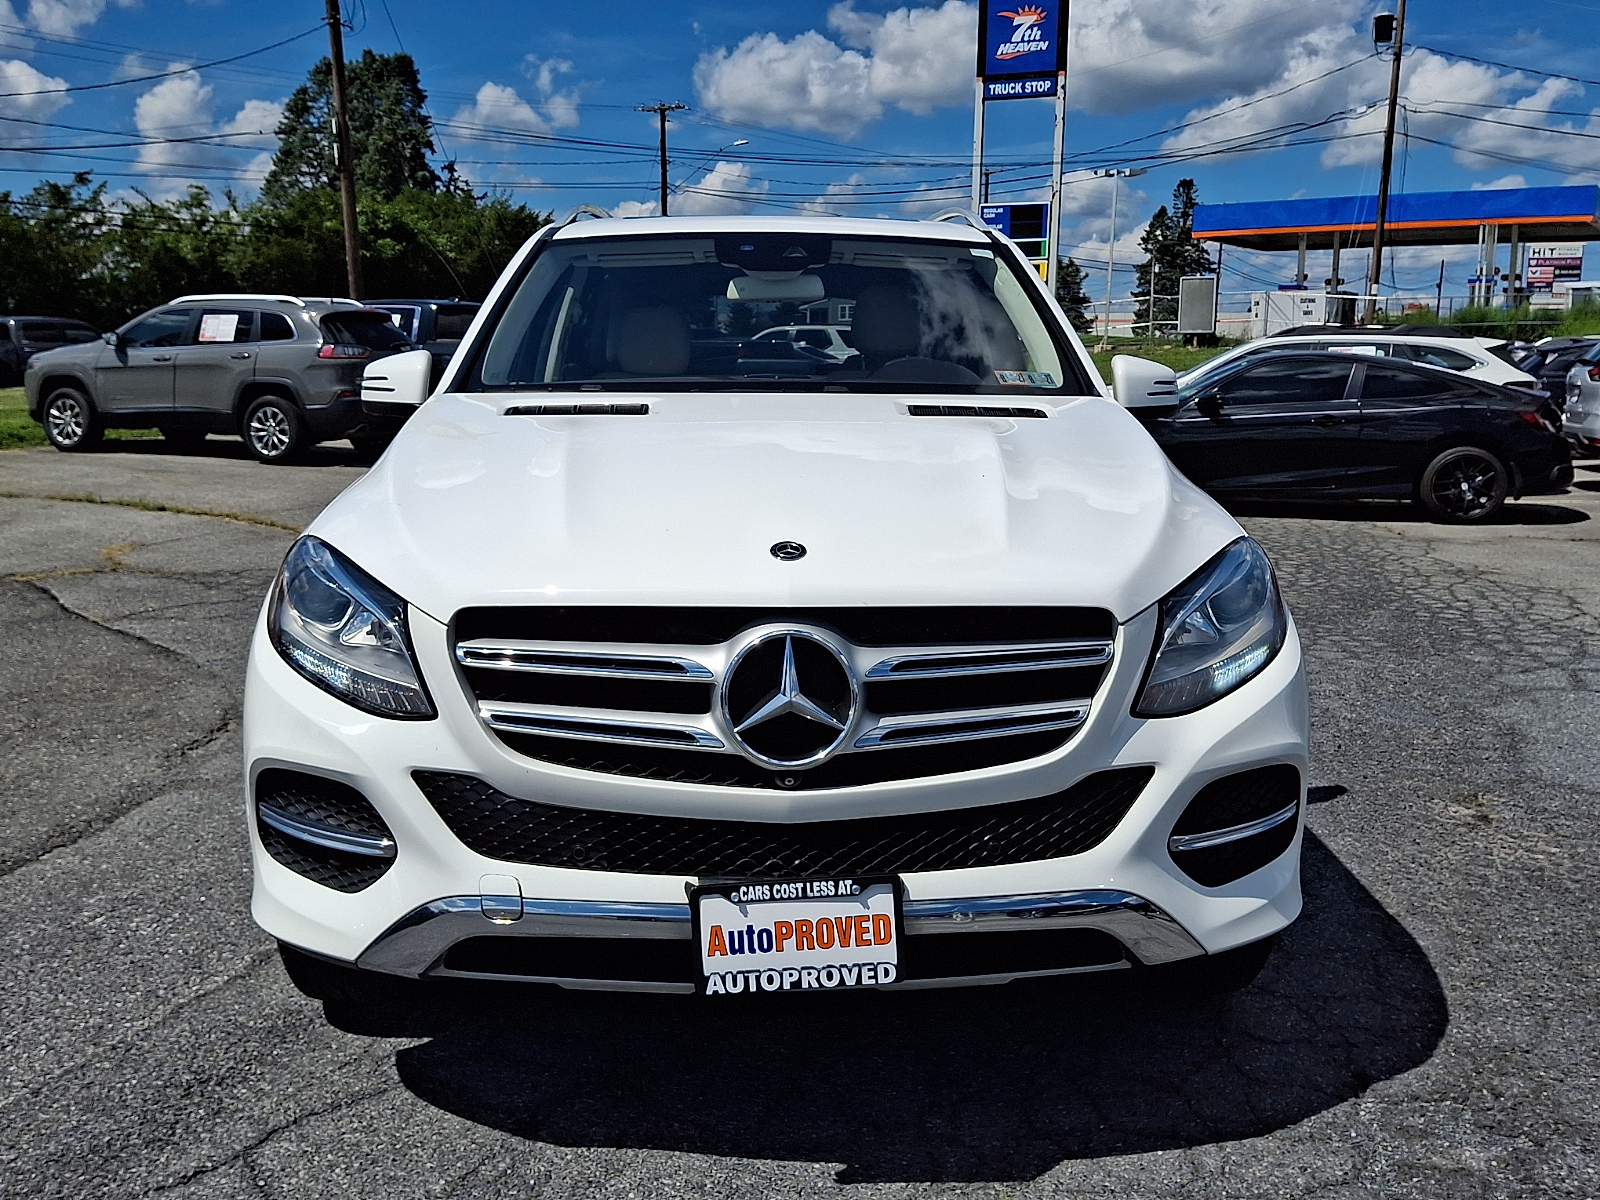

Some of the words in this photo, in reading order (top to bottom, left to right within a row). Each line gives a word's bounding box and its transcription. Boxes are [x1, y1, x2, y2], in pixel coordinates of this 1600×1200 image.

[1011, 15, 1042, 42] 7th
[996, 41, 1049, 55] HEAVEN
[989, 82, 1022, 95] TRUCK
[1025, 80, 1051, 93] STOP
[1532, 247, 1557, 257] HIT
[739, 885, 771, 902] CARS
[772, 883, 804, 899] COST
[806, 881, 836, 897] LESS
[837, 880, 853, 896] AT
[707, 913, 893, 957] AutoPROVED
[705, 963, 897, 995] AUTOPROVED
